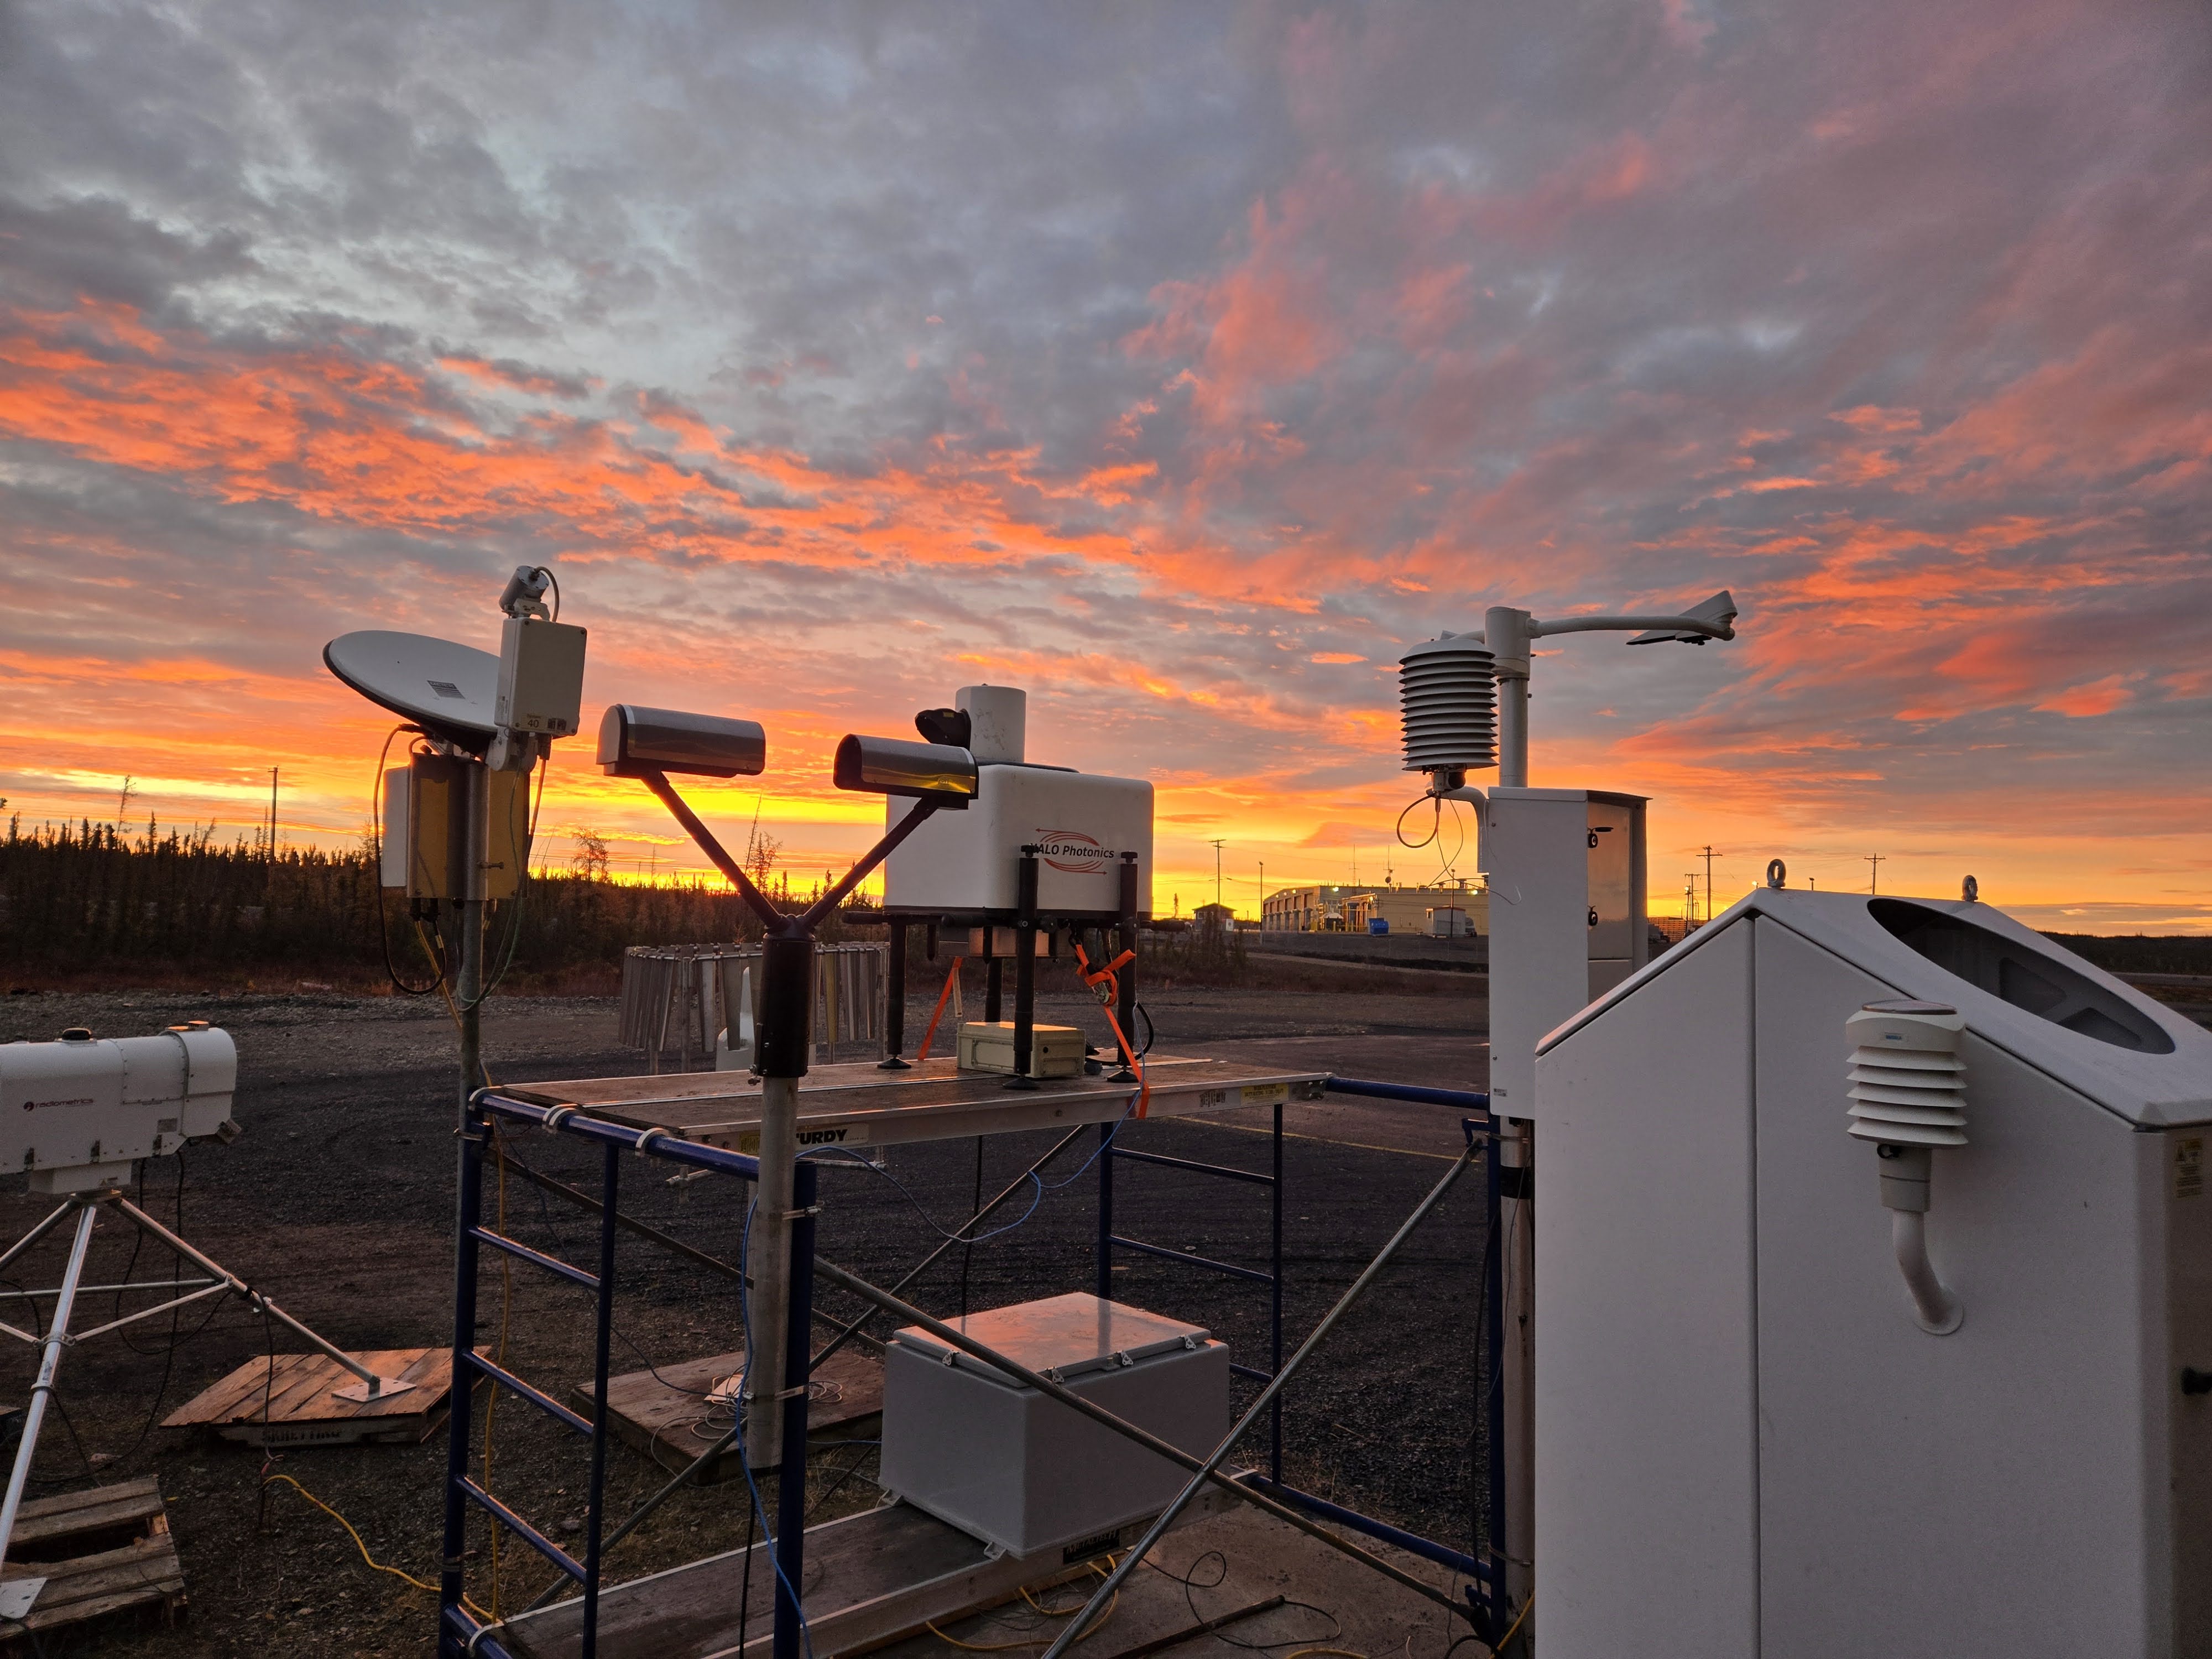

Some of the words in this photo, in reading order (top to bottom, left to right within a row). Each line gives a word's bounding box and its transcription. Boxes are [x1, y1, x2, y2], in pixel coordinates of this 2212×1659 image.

[528, 719, 539, 728] 40
[1062, 845, 1115, 858] Photonics
[35, 1098, 93, 1108] radiometrics
